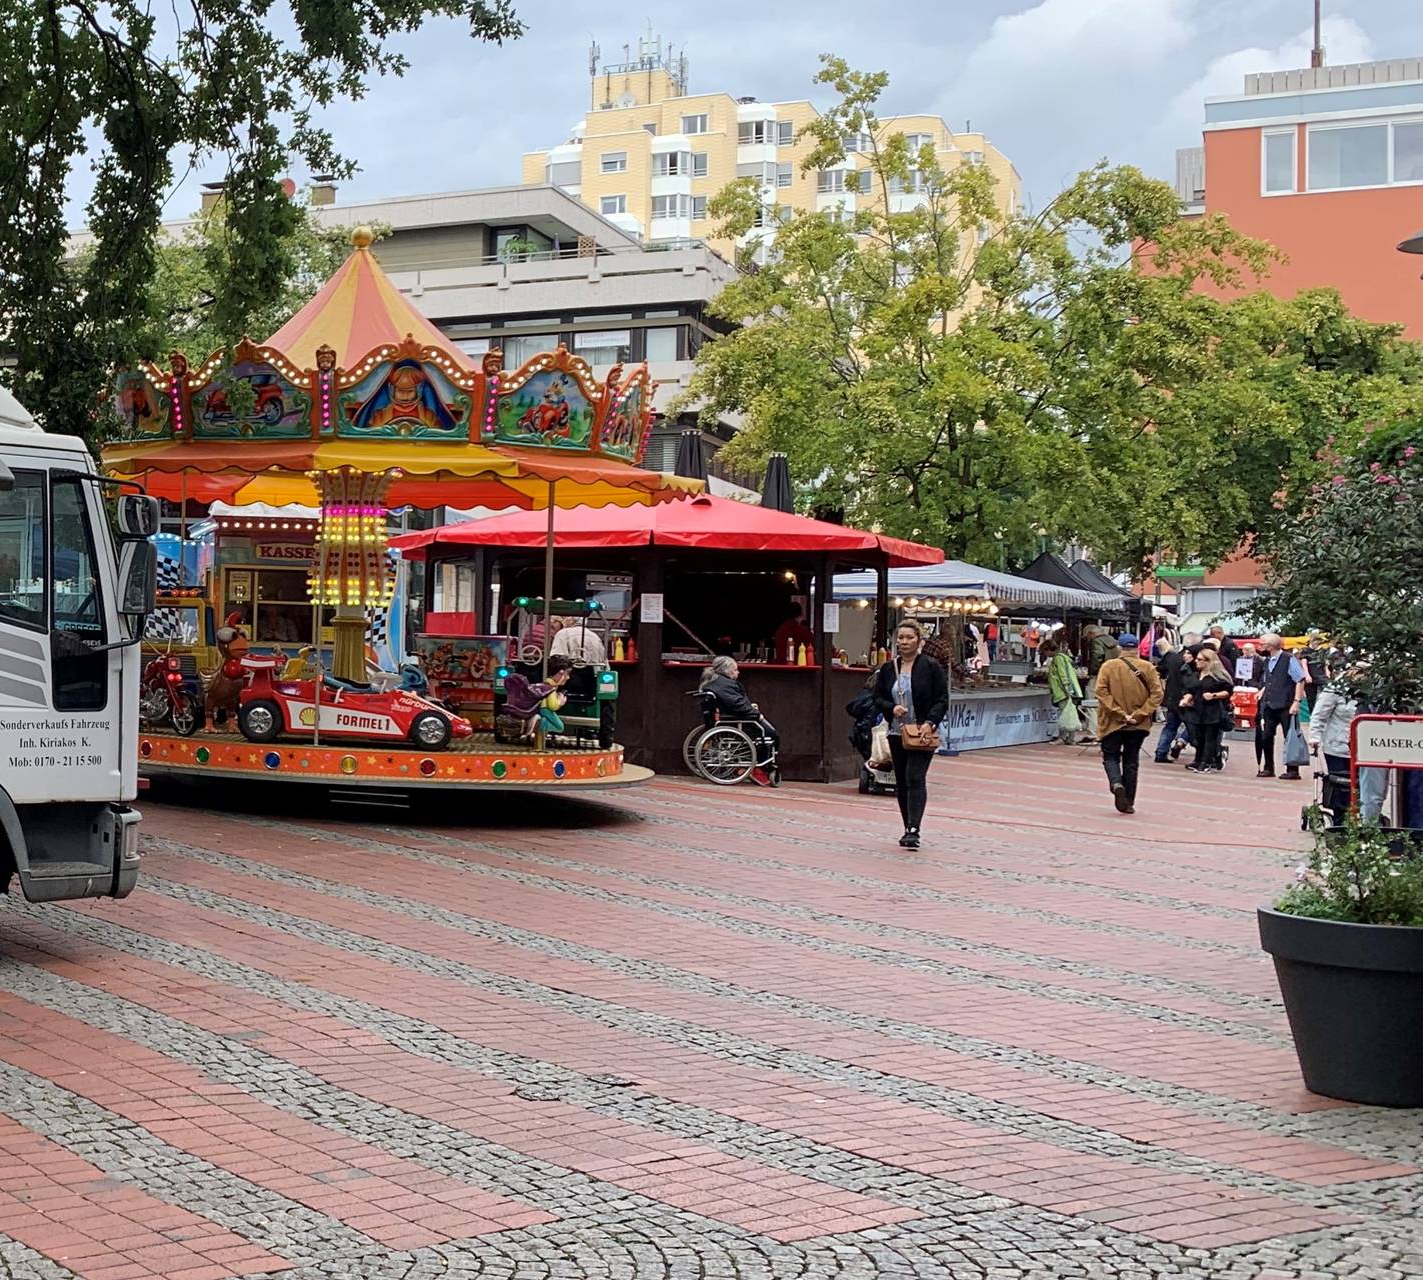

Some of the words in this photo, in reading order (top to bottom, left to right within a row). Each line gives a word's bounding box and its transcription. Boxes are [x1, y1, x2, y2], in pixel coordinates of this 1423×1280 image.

[259, 545, 315, 559] KASSE
[0, 719, 69, 730] Sonderverkaufs
[71, 719, 110, 731] Fahrzeug
[19, 738, 37, 749] Inh.
[40, 737, 77, 748] Kiriakos
[81, 737, 91, 747] K.
[9, 757, 32, 767] Mob:
[34, 757, 55, 767] 0170
[63, 756, 72, 767] 21
[76, 755, 85, 766] 15
[87, 755, 102, 766] 500
